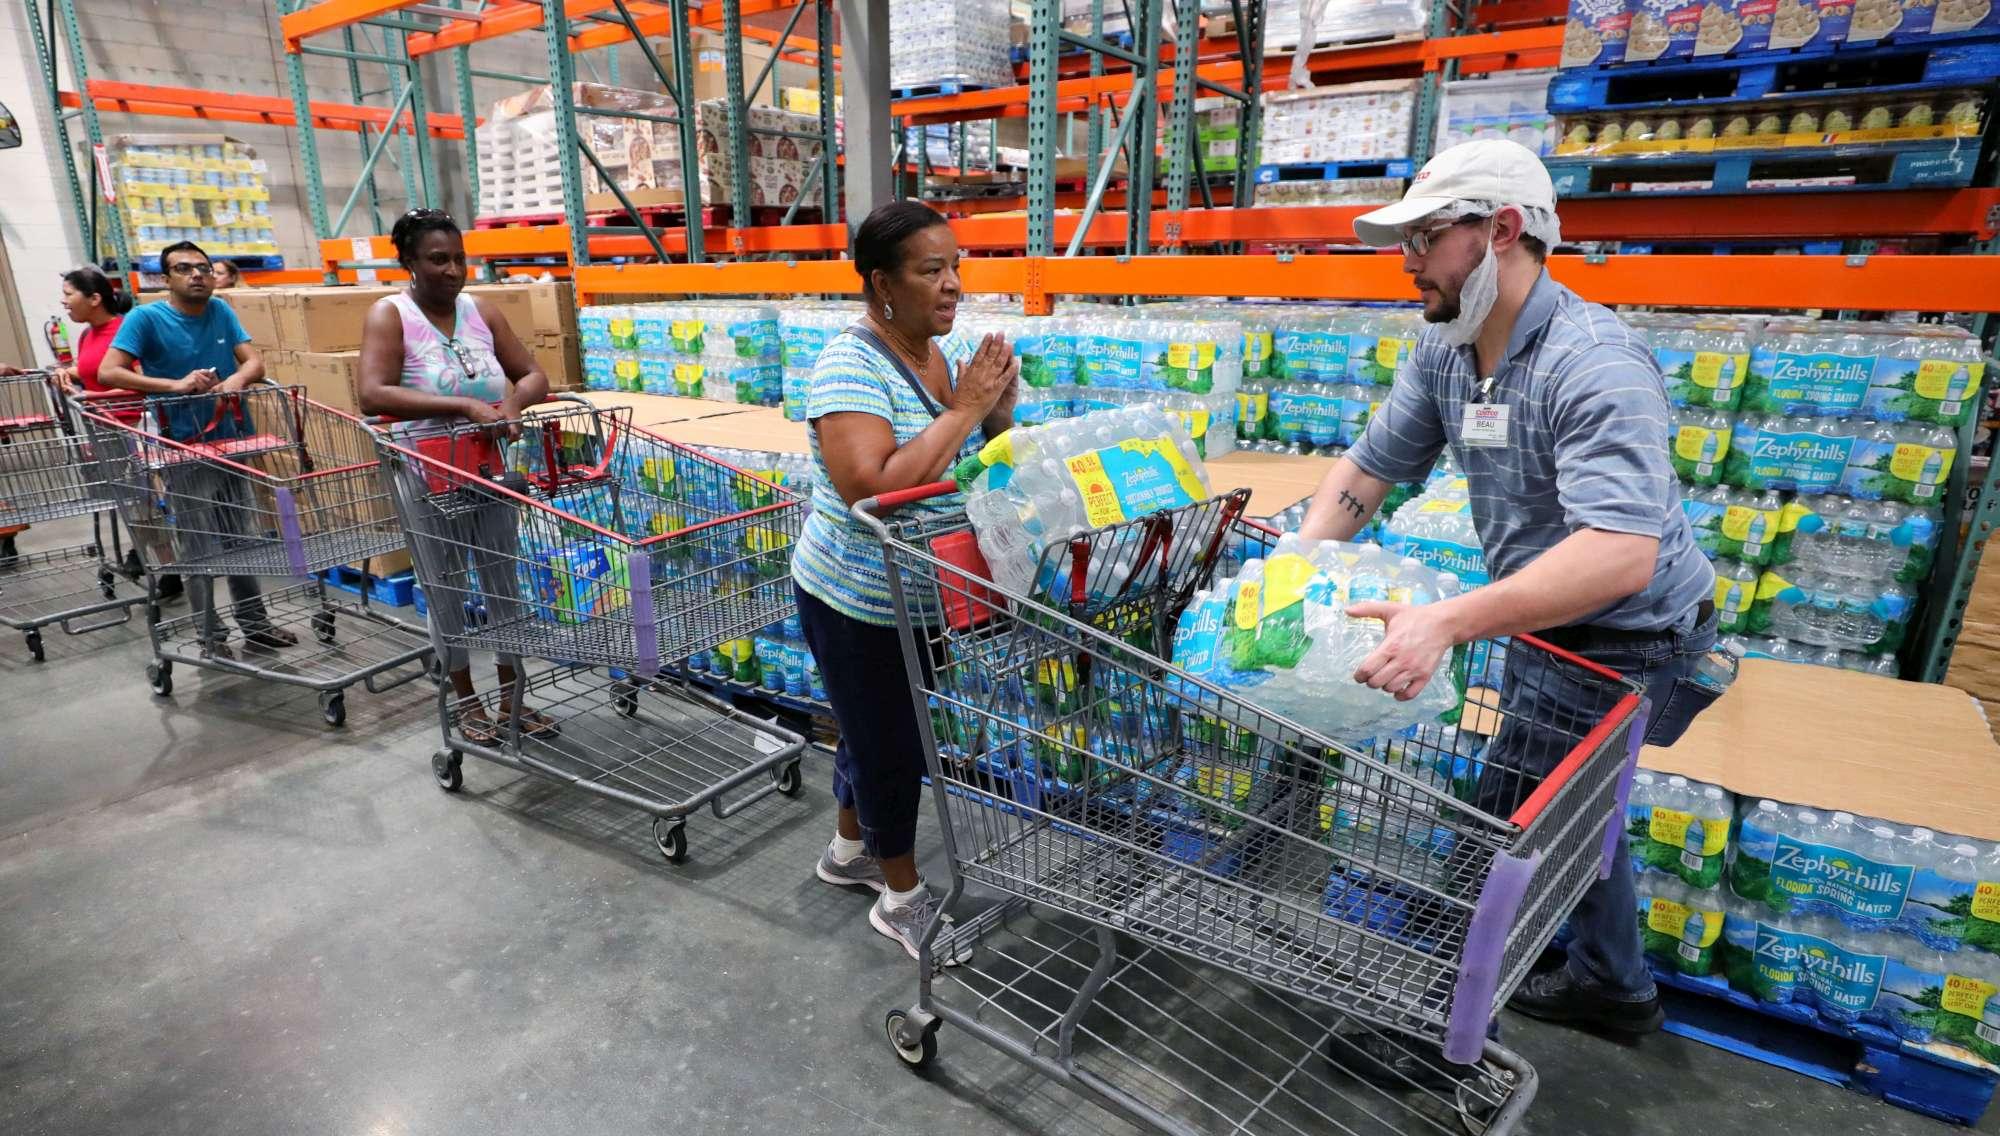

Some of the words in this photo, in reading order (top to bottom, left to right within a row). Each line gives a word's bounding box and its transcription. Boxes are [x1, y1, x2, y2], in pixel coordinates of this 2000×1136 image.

[1287, 336, 1347, 354] Zephyrhills
[1774, 359, 1868, 382] Zephyrhills
[1279, 400, 1340, 418] Zephyrhills
[1754, 438, 1847, 461] Zephyrhills
[1405, 542, 1488, 572] Zephyrhills
[1774, 845, 1902, 893] Zephyrhills
[1776, 876, 1813, 895] FLORIDA
[1816, 885, 1855, 907] SPRING
[1856, 900, 1893, 914] WATER
[1977, 886, 1992, 895] 40
[1653, 902, 1666, 911] 40
[1756, 932, 1876, 984] Zephyrhills
[1760, 964, 1795, 983] FLORIDA
[1833, 990, 1867, 1006] WATER
[1947, 978, 1961, 989] 40
[1947, 991, 1980, 1001] PERFECT
